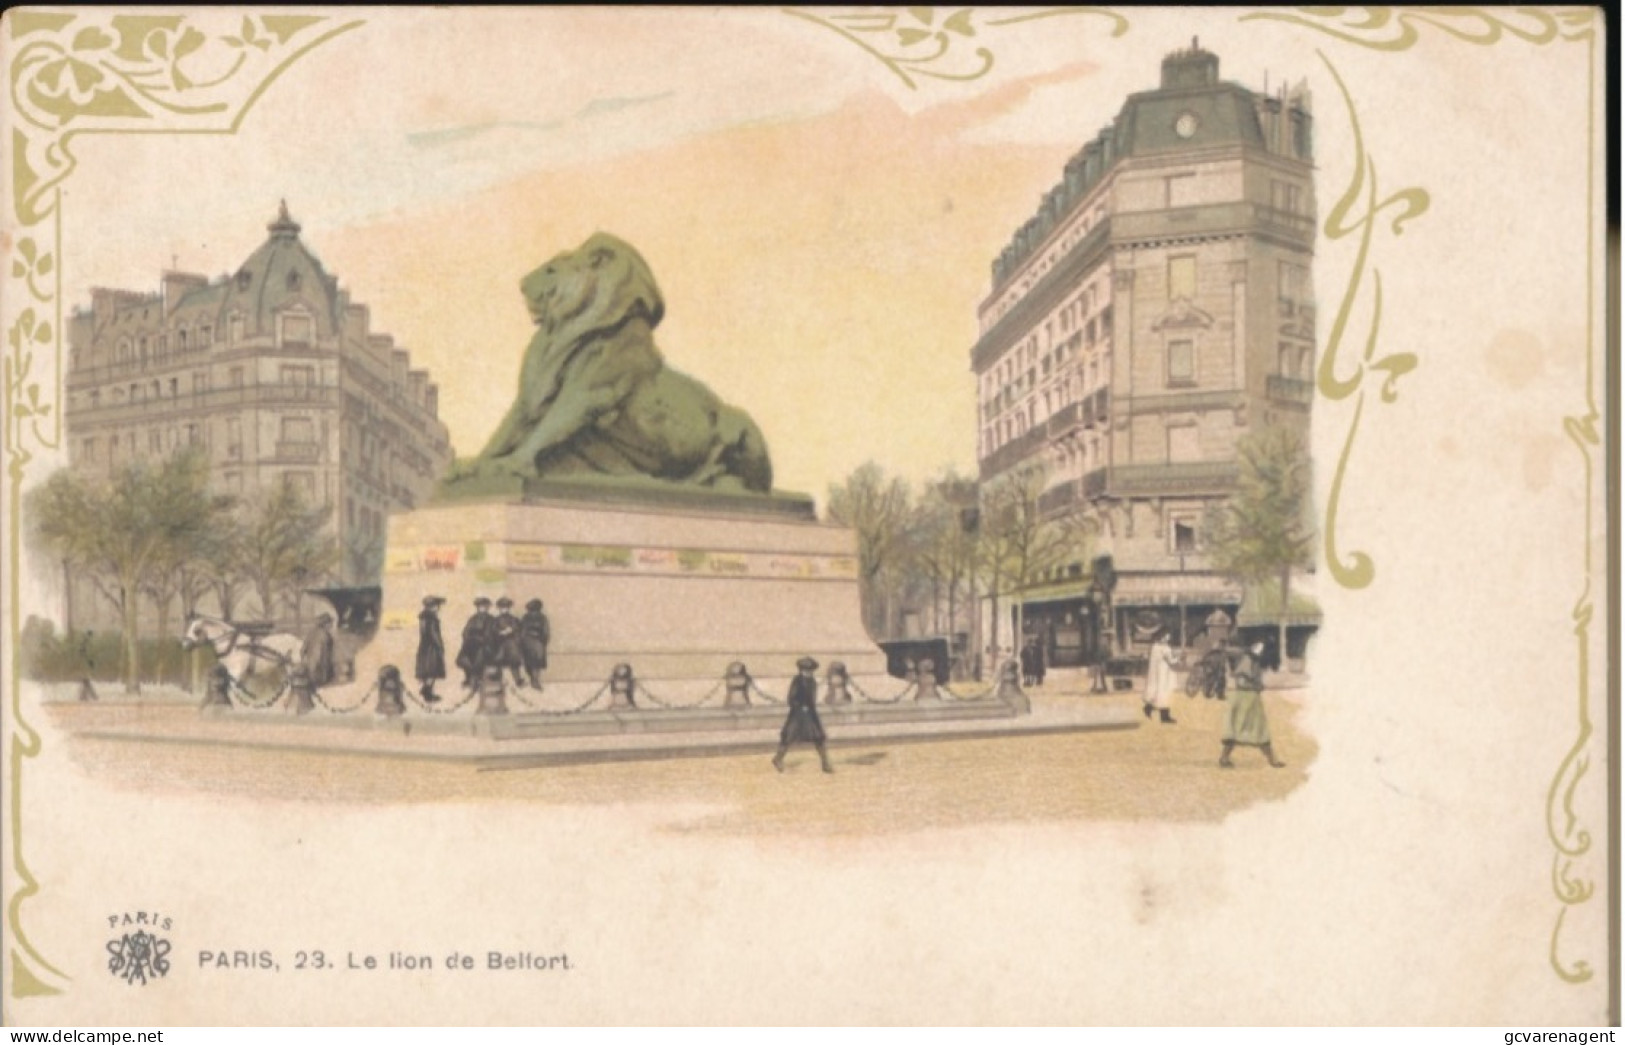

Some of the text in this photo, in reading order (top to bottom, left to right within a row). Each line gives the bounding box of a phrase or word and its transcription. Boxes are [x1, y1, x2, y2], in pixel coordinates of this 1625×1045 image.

[107, 911, 173, 931] PARIS
[198, 950, 280, 971] PARIS,
[295, 950, 334, 970] 23.
[348, 952, 377, 970] Le
[389, 952, 433, 970] lion
[445, 952, 474, 970] de
